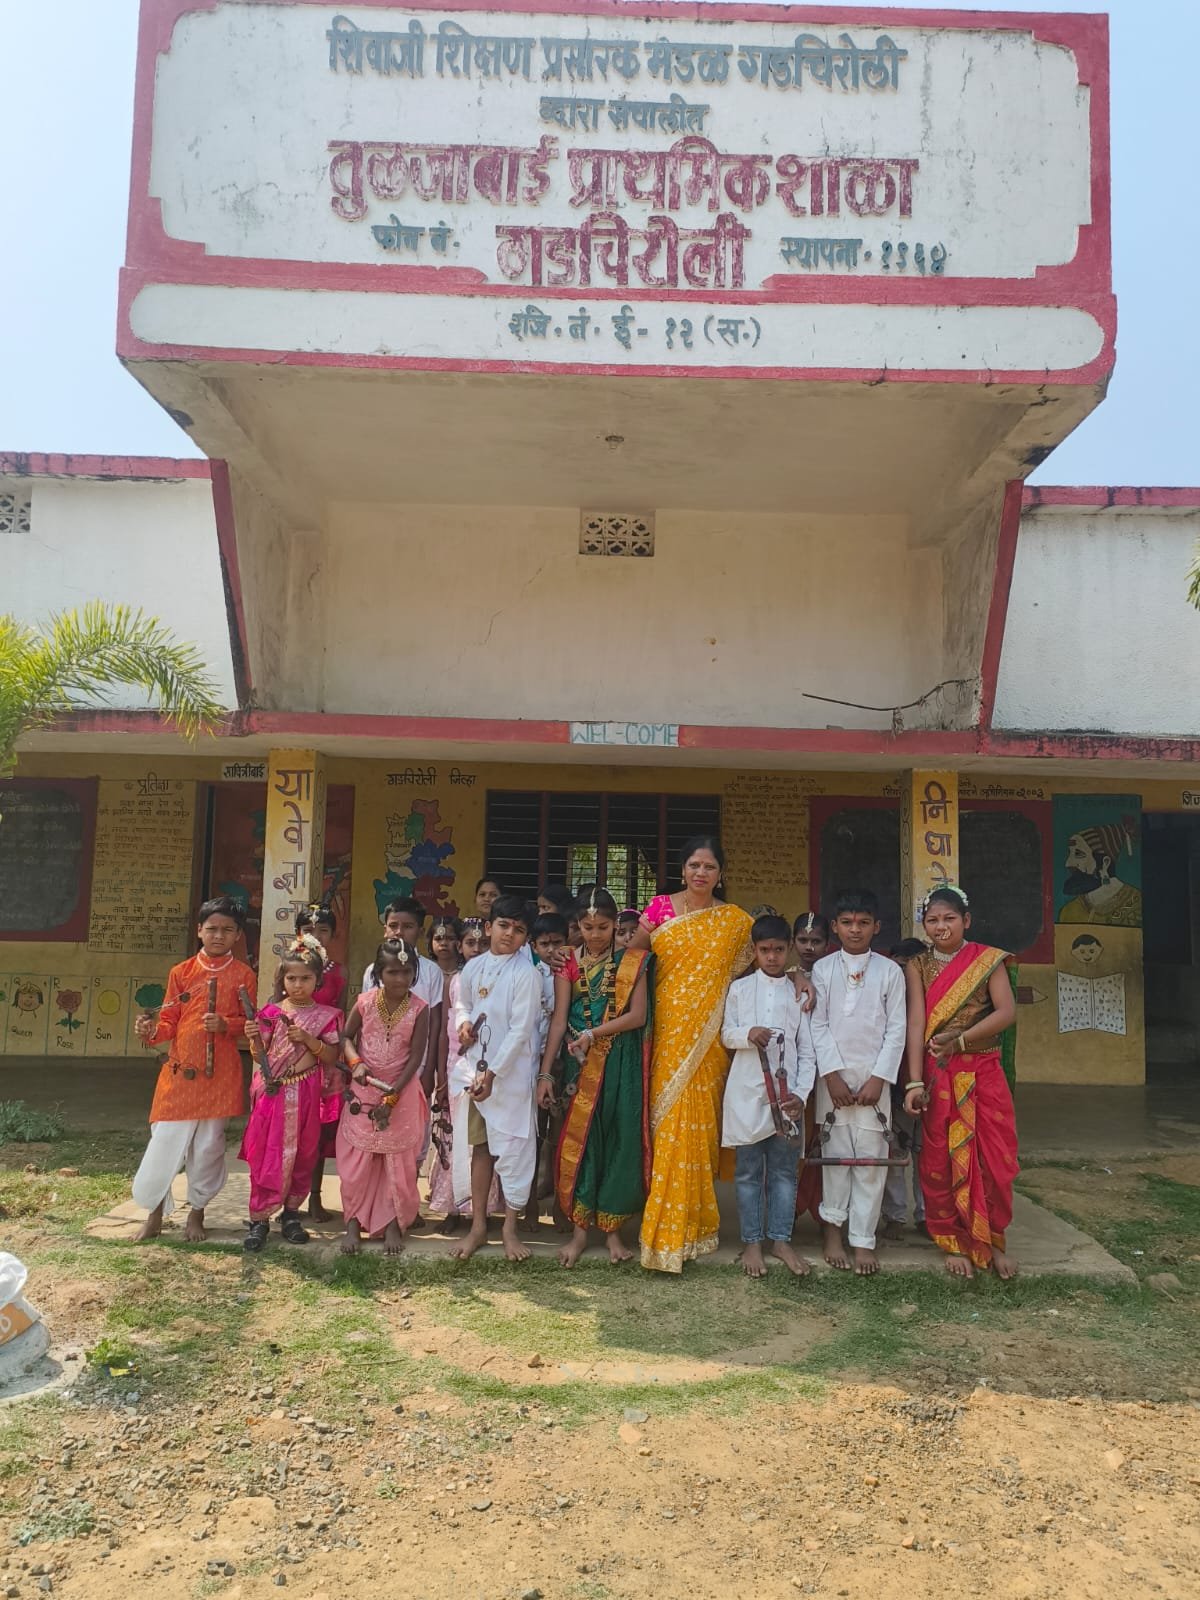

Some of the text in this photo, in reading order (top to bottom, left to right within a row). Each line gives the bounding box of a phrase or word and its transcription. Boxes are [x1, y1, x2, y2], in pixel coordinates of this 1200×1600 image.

[326, 15, 427, 76] शिवाजी
[430, 20, 536, 79] शिक्षण
[540, 37, 639, 81] प्रसारक
[738, 33, 908, 90] गडचिरोली
[327, 134, 919, 221] तुळजाबाई प्राथमिक शाळा
[371, 213, 425, 252] फोन
[496, 211, 752, 288] गडचिरोली
[386, 766, 477, 787] गडचिरोली जिल्हा
[53, 977, 61, 989] R
[94, 978, 101, 987] S
[95, 1027, 112, 1041] Sun
